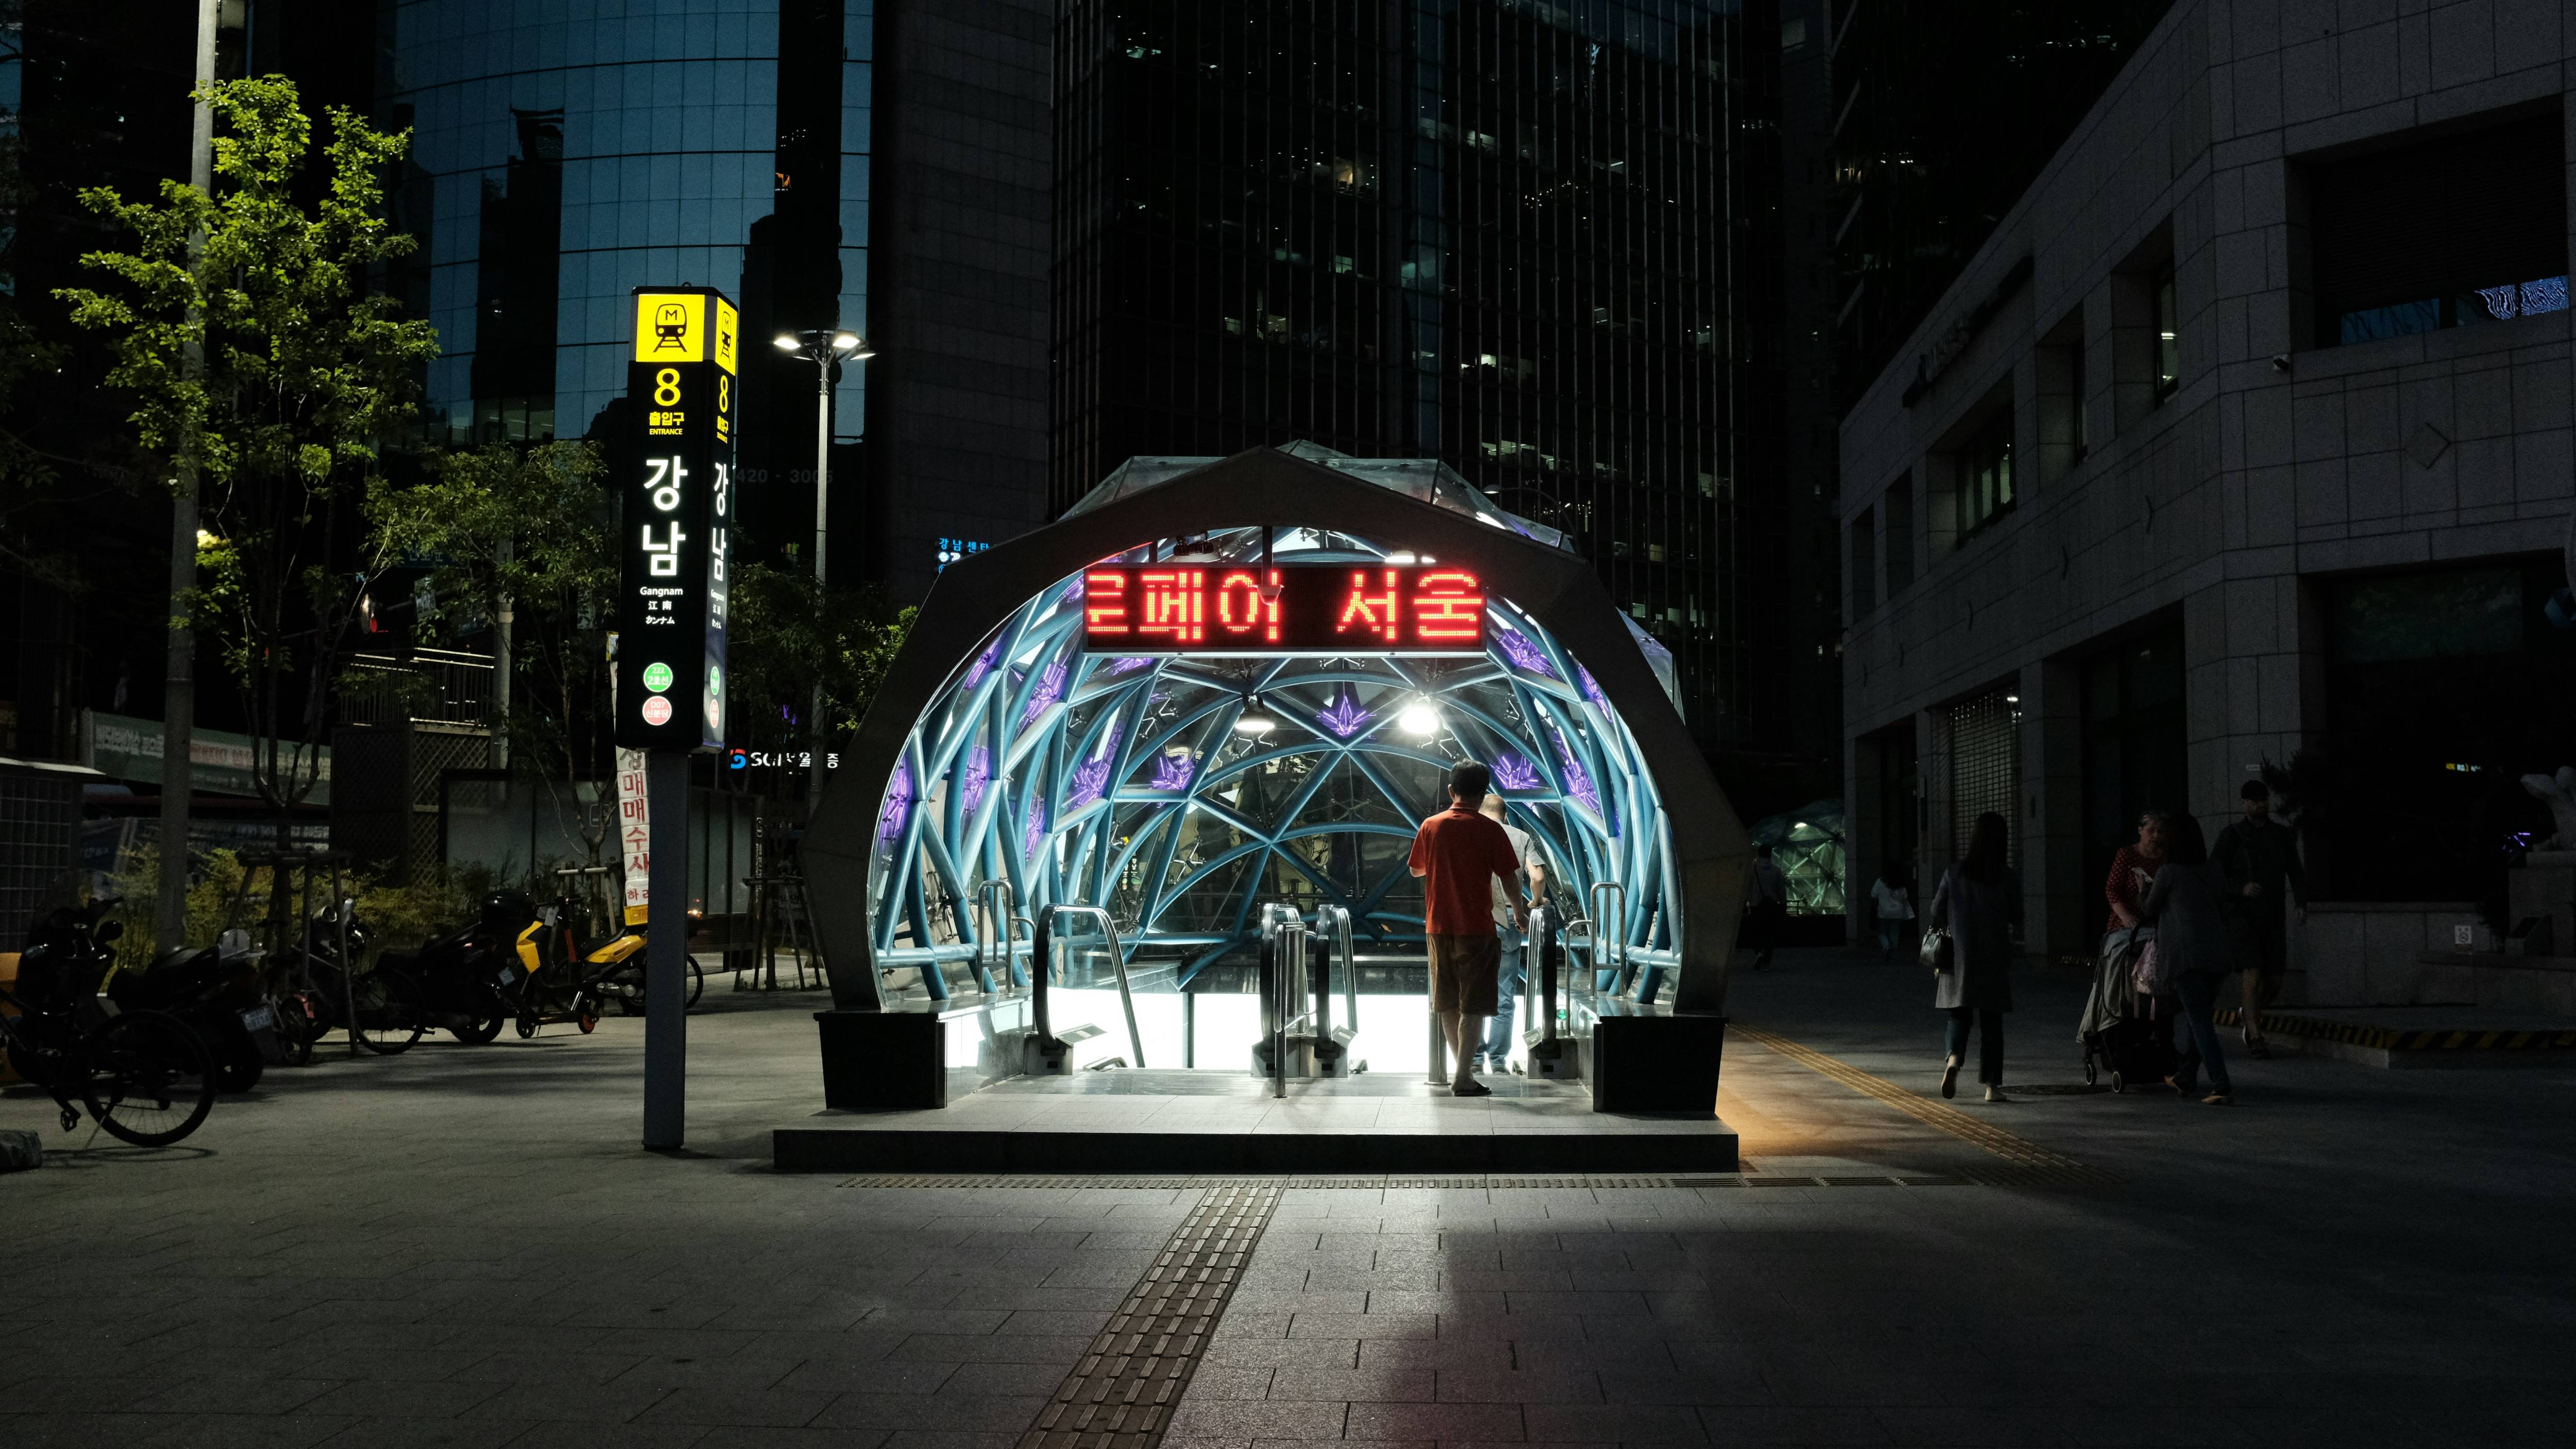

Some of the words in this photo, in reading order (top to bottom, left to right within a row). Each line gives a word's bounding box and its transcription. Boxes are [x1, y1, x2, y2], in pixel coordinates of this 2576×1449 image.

[654, 368, 681, 406] 8
[719, 375, 728, 413] 8
[649, 412, 685, 426] 출입구
[642, 455, 688, 576] 강남
[713, 462, 728, 581] 강남
[640, 586, 684, 598] Gangnam
[1338, 571, 1482, 640] 서울
[645, 615, 675, 625] カンナム
[646, 709, 669, 718] 신분당
